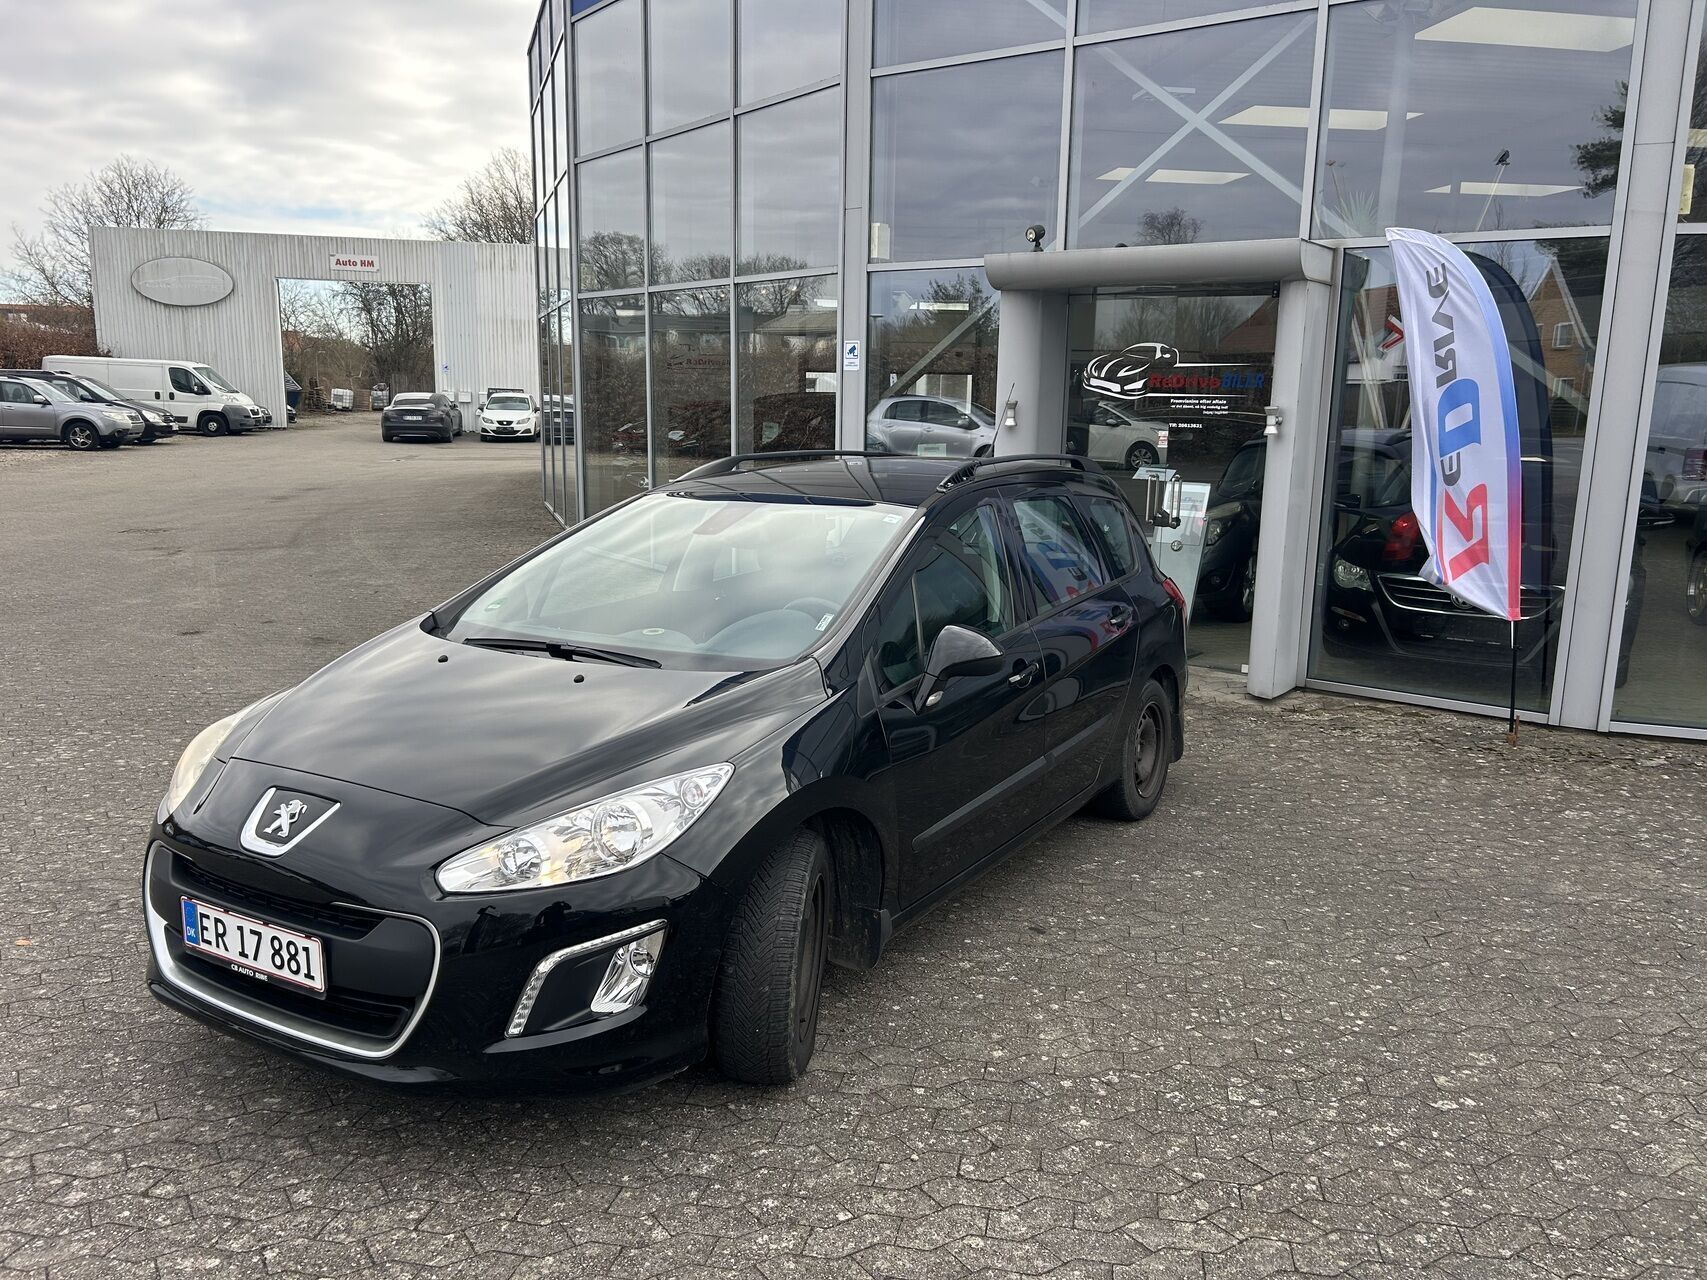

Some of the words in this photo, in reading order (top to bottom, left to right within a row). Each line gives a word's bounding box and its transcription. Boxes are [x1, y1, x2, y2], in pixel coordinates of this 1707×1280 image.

[335, 258, 358, 267] Auto
[360, 259, 375, 268] HM
[186, 925, 196, 938] DK
[198, 912, 229, 952] ER
[236, 925, 263, 962] 17
[270, 935, 315, 981] 881
[238, 966, 254, 977] AUTO
[255, 972, 268, 982] RIBE
